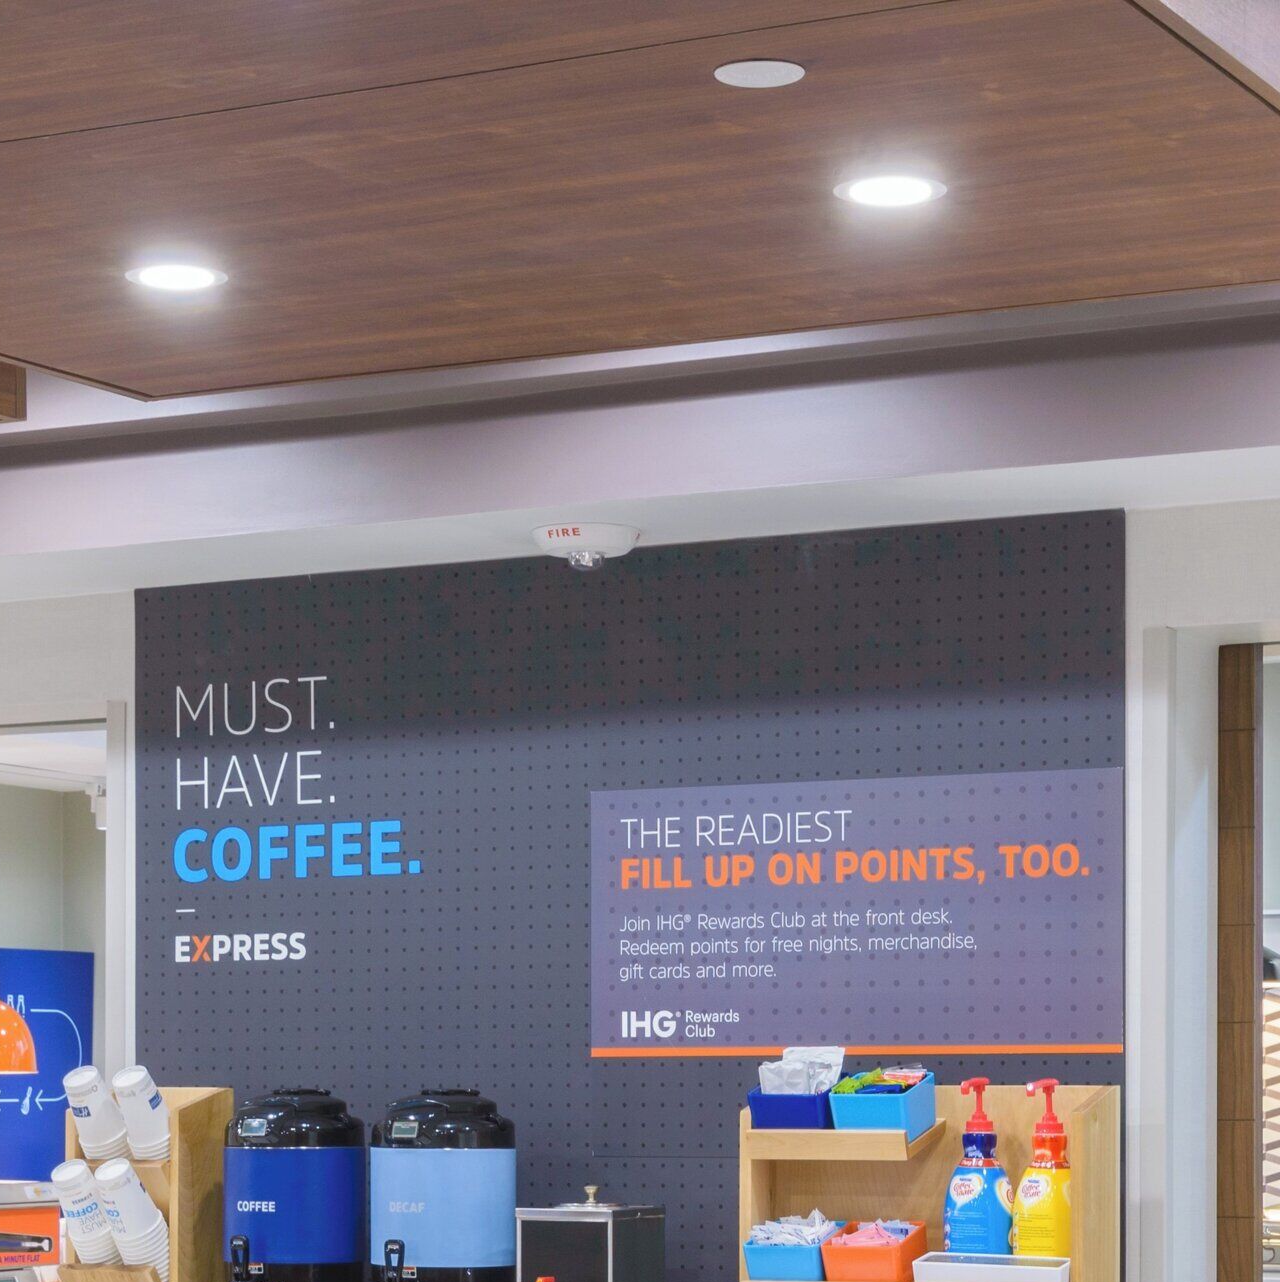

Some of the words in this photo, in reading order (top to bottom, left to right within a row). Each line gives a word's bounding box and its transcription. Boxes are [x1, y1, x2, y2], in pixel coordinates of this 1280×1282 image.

[547, 527, 581, 538] FIRE
[176, 676, 335, 738] MUST.
[176, 750, 335, 810] HAVE.
[620, 817, 680, 849] THE
[696, 810, 852, 847] READIEST
[173, 820, 421, 883] COFFEE.
[621, 856, 692, 889] FILL
[705, 854, 755, 887] UP
[768, 852, 821, 885] ON
[834, 846, 985, 885] POINTS,
[998, 843, 1090, 878] TOO.
[620, 916, 650, 932] Join
[697, 913, 765, 930] Rewards
[770, 912, 806, 928] Club
[811, 912, 827, 927] at
[833, 910, 860, 926] the
[866, 909, 905, 925] front
[911, 908, 953, 924] desk.
[175, 932, 307, 963] EXPRESS
[620, 940, 684, 955] Redeem
[691, 938, 739, 956] points
[744, 937, 766, 953] for
[772, 936, 803, 952] free
[809, 935, 862, 954] nights,
[868, 933, 977, 950] merchandise,
[620, 963, 644, 982] gift
[649, 963, 691, 979] cards
[696, 962, 726, 978] and
[732, 964, 777, 978] more.
[685, 1009, 740, 1023] Rewards
[685, 1024, 716, 1038] Club
[237, 1200, 276, 1212] COFFEE
[389, 1201, 425, 1214] DECAF
[4, 1255, 25, 1263] MINUTE
[27, 1254, 40, 1262] FLAT
